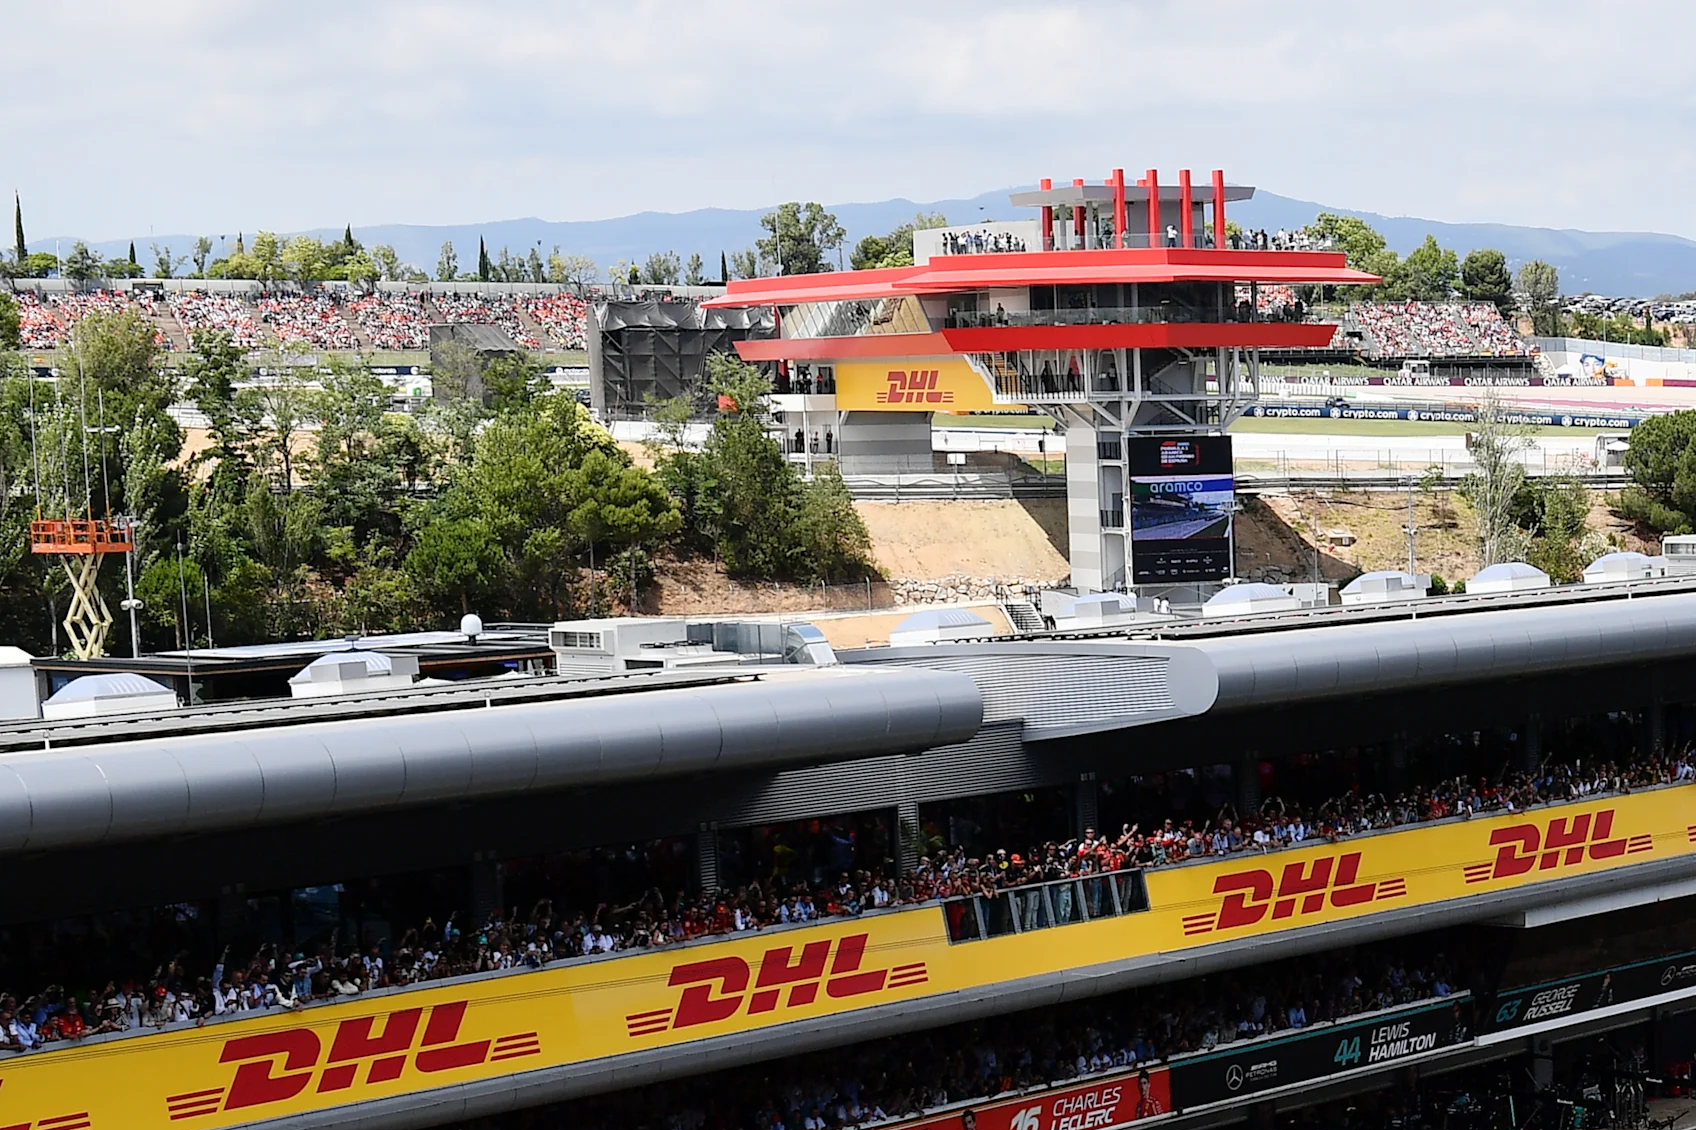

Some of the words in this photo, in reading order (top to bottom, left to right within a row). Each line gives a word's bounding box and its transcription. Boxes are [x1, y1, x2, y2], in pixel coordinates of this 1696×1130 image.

[887, 370, 945, 403] DHL
[1302, 376, 1330, 386] QATAR
[1333, 376, 1369, 385] AIRWAYS
[1383, 377, 1412, 386] QATAR
[1414, 377, 1450, 386] AIRWAYS
[1464, 377, 1493, 387] QATAR
[1495, 377, 1530, 386] AIRWAYS
[1543, 377, 1571, 387] QATAR
[1573, 377, 1607, 386] AIRWAYS
[1266, 407, 1321, 418] crypto.com
[1343, 409, 1398, 420] crypto.com
[1420, 410, 1474, 422] crypto.com
[1574, 417, 1629, 429] crypto.com
[1150, 482, 1203, 493] aramco
[1489, 809, 1628, 878] DHL
[1212, 852, 1377, 930] DHL
[667, 933, 888, 1028] DHL
[1496, 999, 1523, 1023] 63
[1531, 984, 1581, 1006] GEORGE
[1522, 998, 1574, 1022] RUSSELL
[218, 1000, 491, 1111] DHL
[1333, 1036, 1362, 1067] 44
[1371, 1021, 1411, 1045] LEWIS
[1368, 1032, 1437, 1063] HAMILTON
[1052, 1086, 1122, 1118] CHARLES
